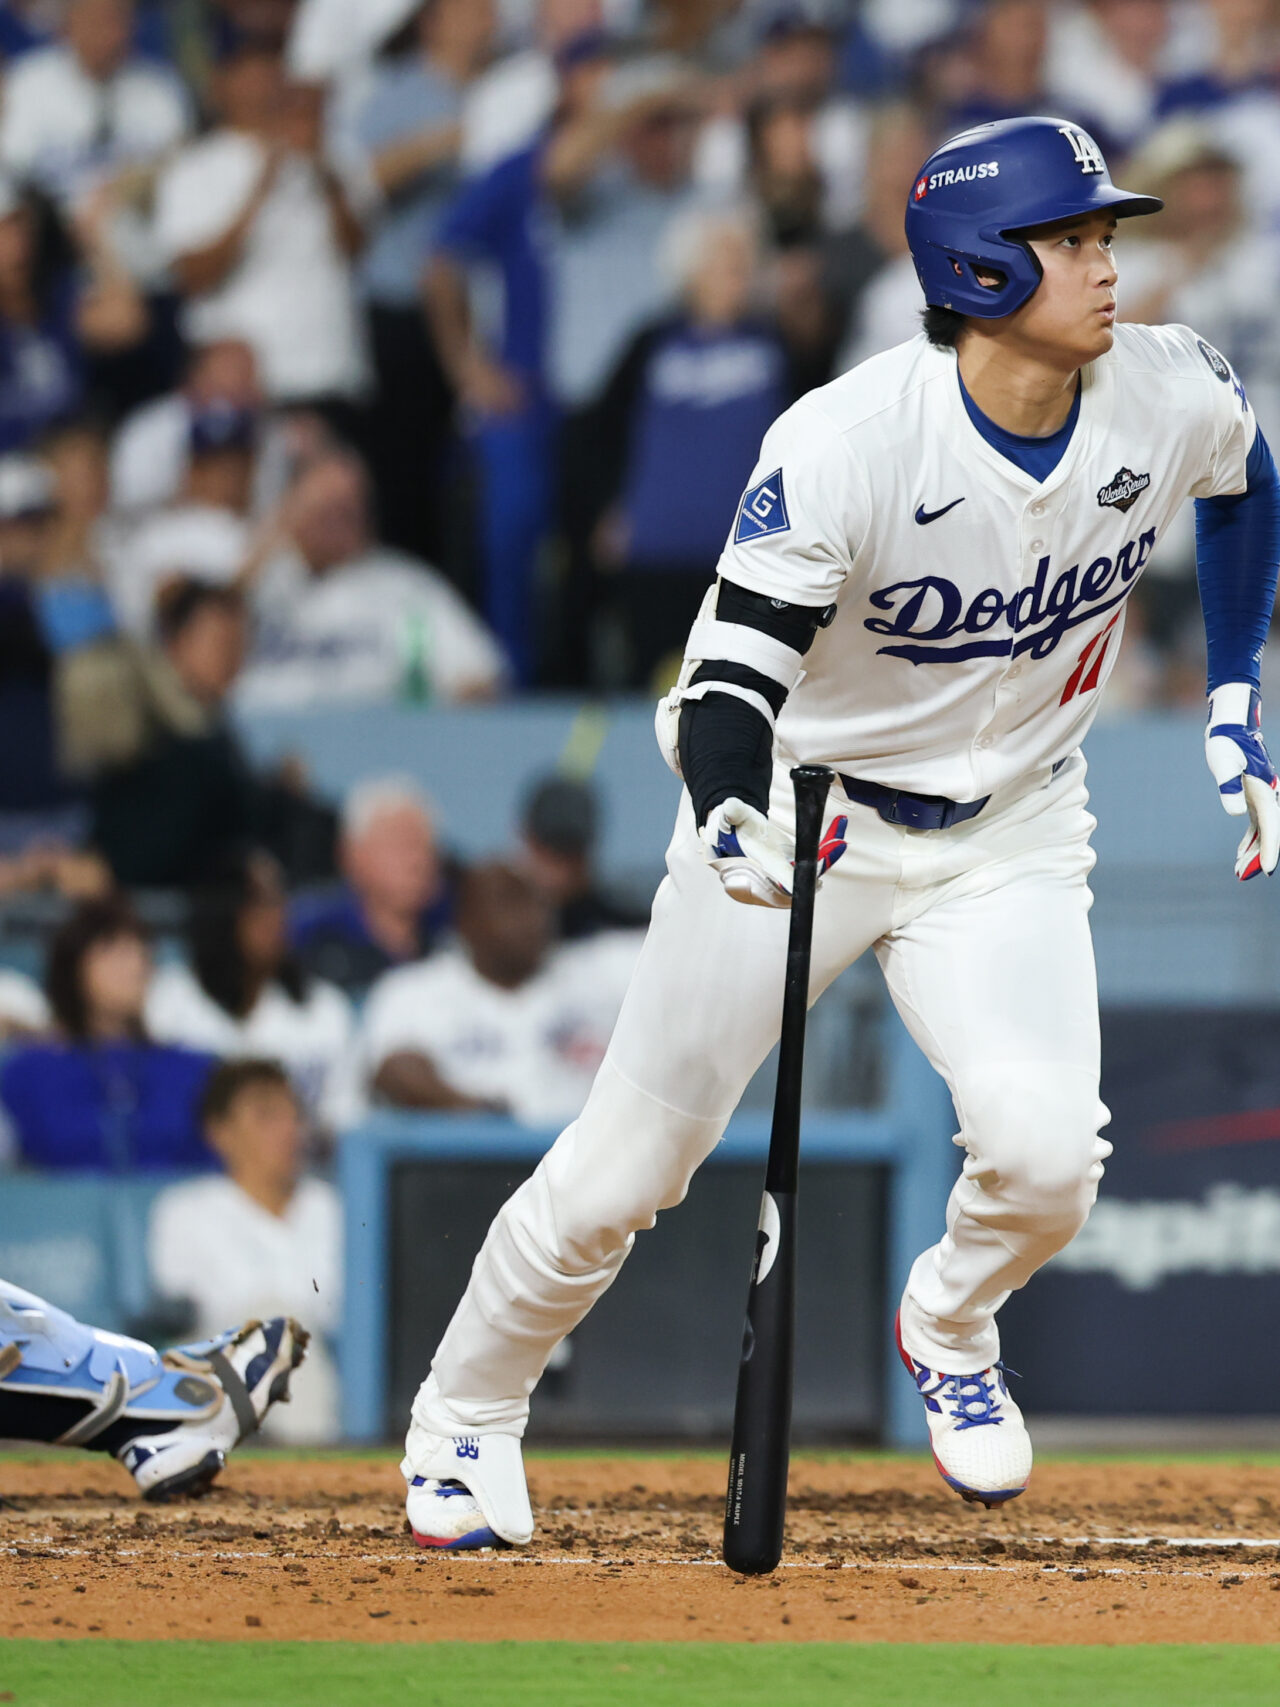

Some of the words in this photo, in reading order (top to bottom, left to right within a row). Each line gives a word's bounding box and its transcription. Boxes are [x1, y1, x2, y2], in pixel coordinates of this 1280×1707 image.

[1058, 127, 1104, 174] LA
[929, 161, 999, 190] STRAUSS
[751, 486, 778, 518] G
[863, 526, 1156, 661] Dodgers
